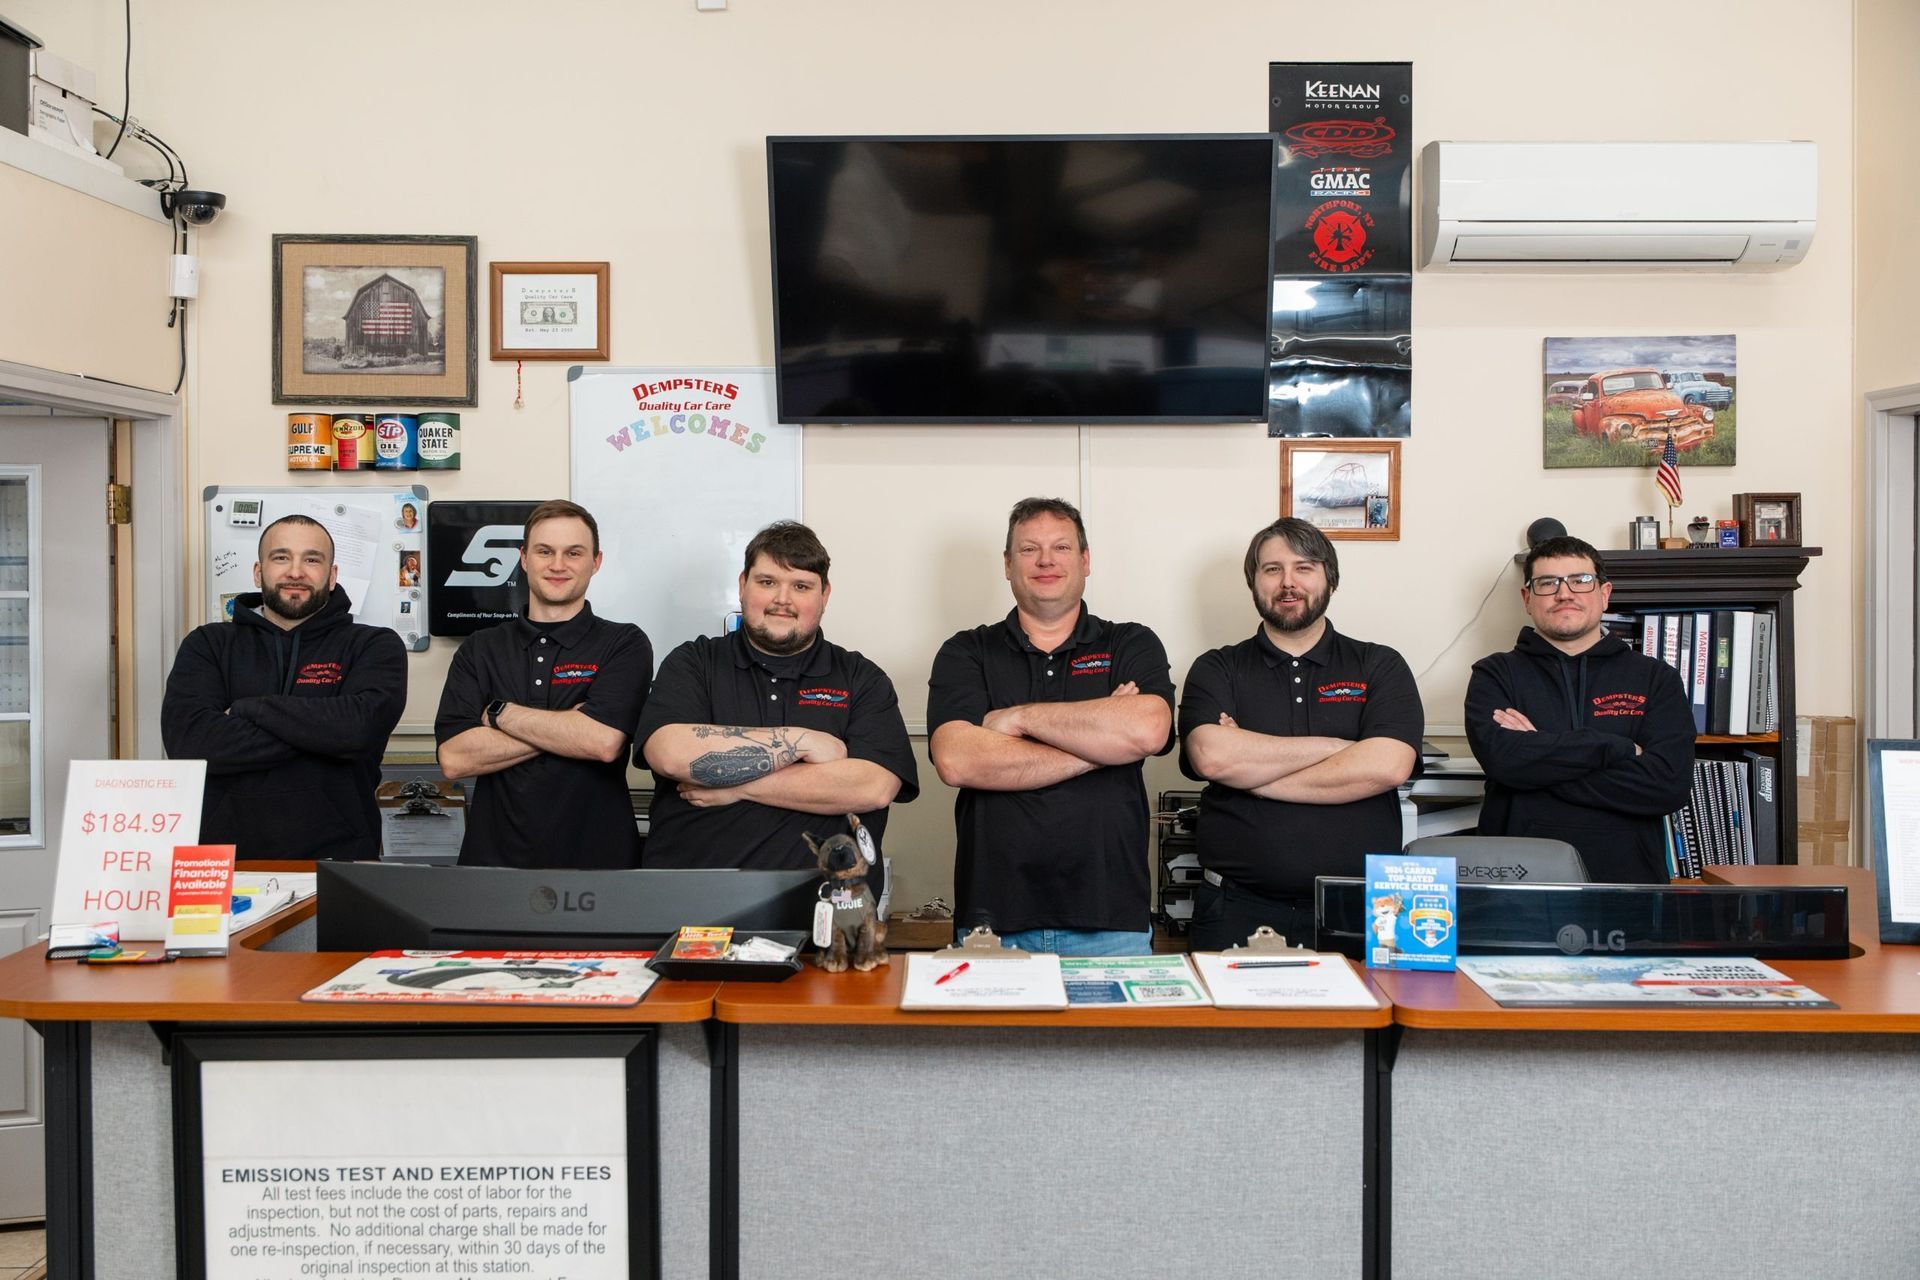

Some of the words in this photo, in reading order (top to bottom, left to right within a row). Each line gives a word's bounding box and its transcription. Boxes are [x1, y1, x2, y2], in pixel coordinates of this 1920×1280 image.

[1305, 80, 1380, 99] KEENAN
[1310, 173, 1371, 189] GMAC
[1307, 252, 1337, 273] FIRE
[632, 378, 739, 401] DEMPSTERS
[638, 401, 681, 413] Quality
[683, 401, 703, 411] Car
[705, 401, 732, 411] Care
[291, 422, 313, 435] GULF
[333, 425, 365, 434] PENNZOIL
[378, 424, 404, 438] STP
[418, 427, 453, 438] QUAKER
[606, 413, 767, 453] WELCOMES
[421, 438, 448, 449] STATE
[1645, 625, 1654, 658] 4RUNNE
[1696, 631, 1708, 685] MARKETING
[1592, 693, 1647, 706] DEMPSTERS
[1593, 709, 1619, 717] Quality
[95, 778, 155, 789] DIAGNOSTIC
[156, 778, 177, 789] FEE:
[81, 811, 182, 835] $184.97
[102, 851, 152, 872] PER
[174, 858, 231, 868] Promotional
[173, 868, 229, 880] Financing
[1404, 866, 1438, 876] CARFAX
[173, 879, 227, 890] Available
[1373, 882, 1410, 891] SERVICE
[84, 890, 161, 911] HOUR
[563, 890, 596, 912] LG
[837, 898, 863, 910] LOUIE
[1592, 929, 1626, 951] LG
[222, 1168, 330, 1183] EMISSIONS
[336, 1167, 386, 1182] TEST
[392, 1166, 433, 1182] AND
[441, 1166, 554, 1181] EXEMPTION
[561, 1166, 611, 1180] FEES
[262, 1187, 280, 1201] All
[285, 1187, 311, 1201] test
[316, 1186, 346, 1200] fees
[351, 1186, 401, 1200] include
[407, 1186, 429, 1199] the
[433, 1186, 463, 1199] cost
[467, 1185, 481, 1199] of
[486, 1185, 522, 1199] labor
[526, 1185, 544, 1199] for
[550, 1185, 572, 1199] the
[247, 1205, 324, 1221] inspection,
[329, 1204, 352, 1219] but
[356, 1205, 379, 1218] not
[383, 1204, 405, 1218] the
[410, 1204, 440, 1218] cost
[444, 1203, 458, 1218] of
[462, 1204, 502, 1221] parts,
[507, 1203, 557, 1221] repairs
[561, 1203, 588, 1217] and
[229, 1224, 320, 1241] adjustments.
[330, 1223, 350, 1237] No
[355, 1222, 424, 1237] additional
[429, 1222, 478, 1240] charge
[482, 1222, 515, 1236] shall
[520, 1222, 538, 1236] be
[543, 1221, 583, 1236] made
[588, 1221, 607, 1236] for
[230, 1244, 258, 1256] one
[262, 1242, 359, 1259] re-inspection,
[364, 1241, 373, 1255] if
[377, 1242, 452, 1258] necessary,
[458, 1240, 499, 1255] within
[504, 1241, 522, 1255] 30
[526, 1240, 561, 1258] days
[564, 1240, 580, 1254] of
[583, 1240, 606, 1254] the
[301, 1260, 353, 1277] original
[358, 1259, 431, 1276] inspection
[435, 1260, 449, 1273] at
[453, 1259, 478, 1273] this
[482, 1259, 534, 1273] station.
